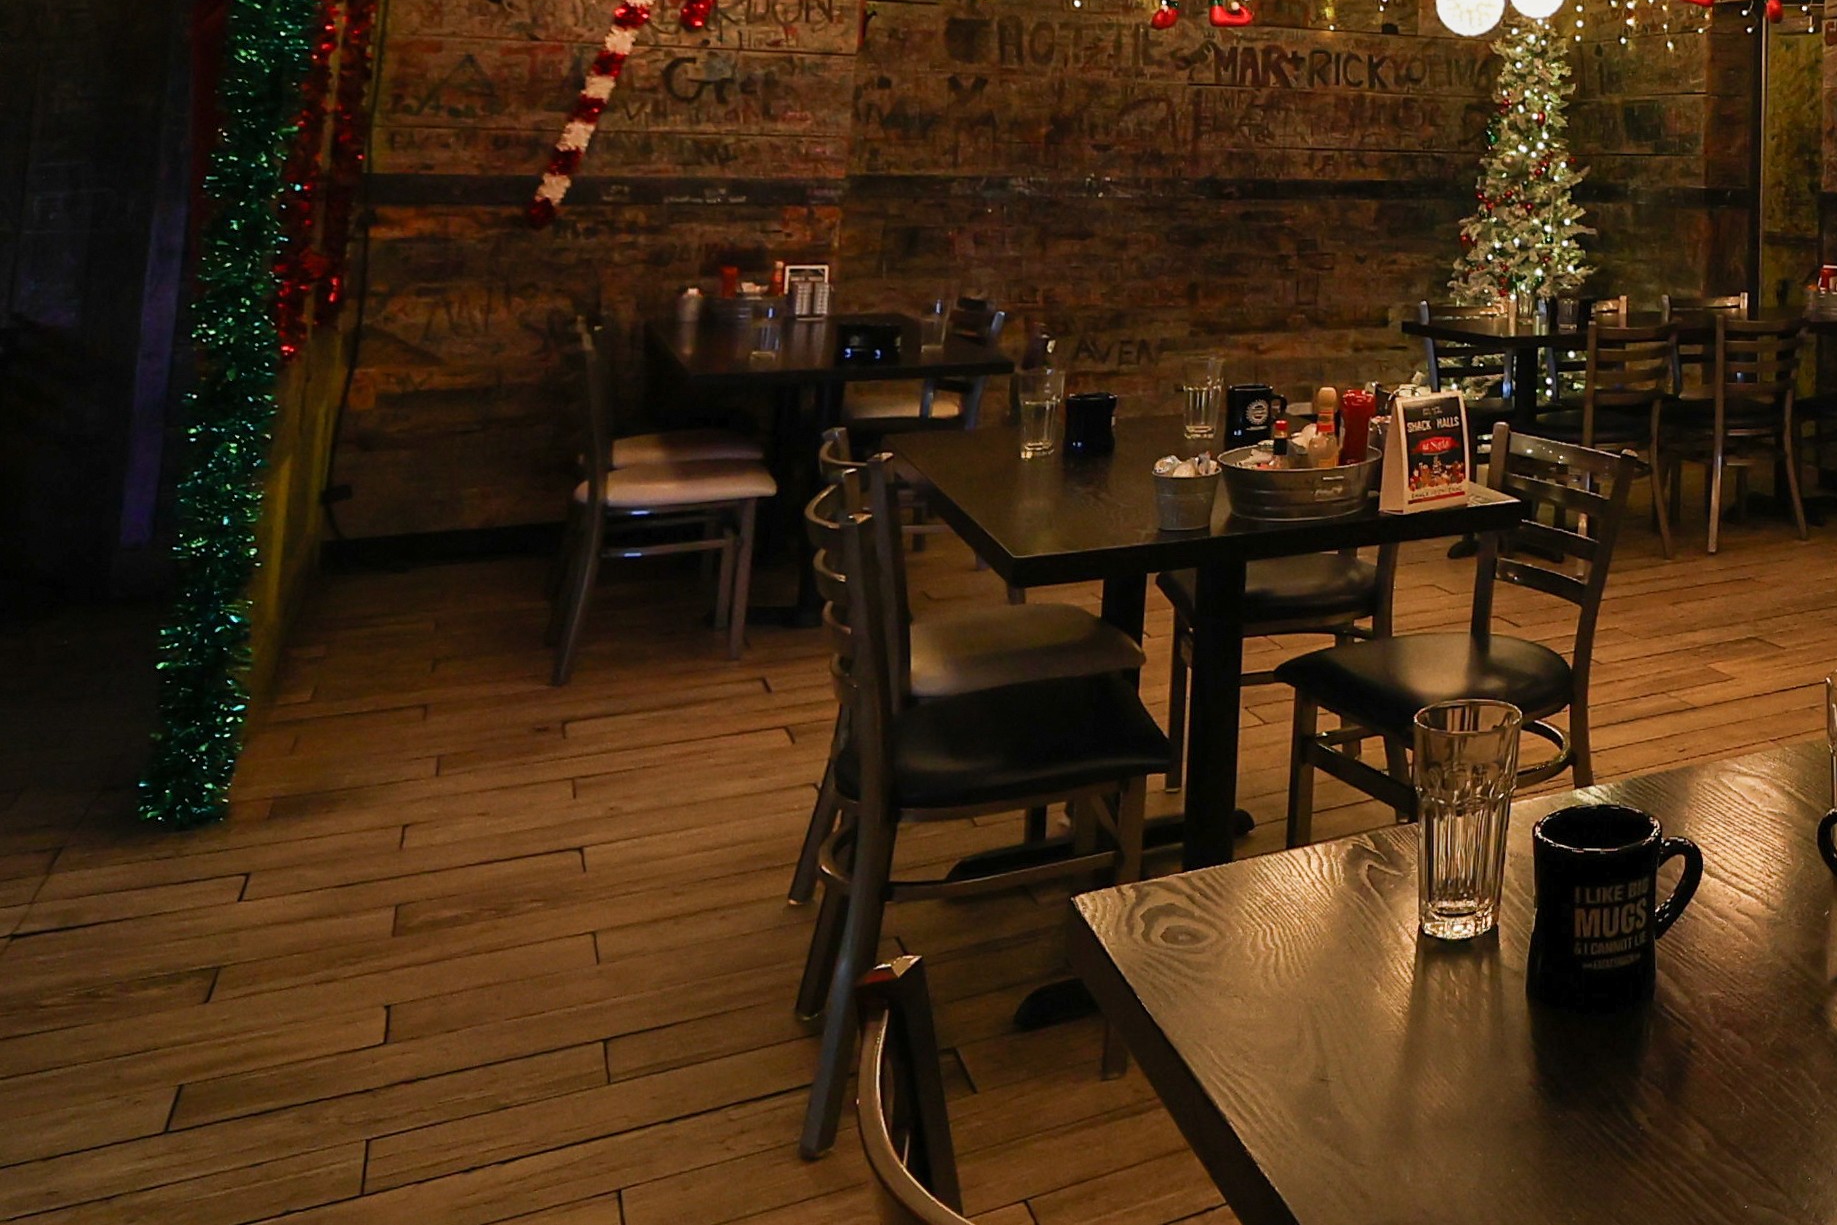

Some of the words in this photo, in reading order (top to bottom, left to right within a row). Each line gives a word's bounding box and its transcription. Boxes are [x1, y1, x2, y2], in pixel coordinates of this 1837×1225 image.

[1574, 885, 1581, 904] I
[1584, 884, 1626, 904] LIKE
[1627, 876, 1650, 900] BIG
[1573, 897, 1648, 939] MUGS
[1590, 937, 1633, 956] CANNOT
